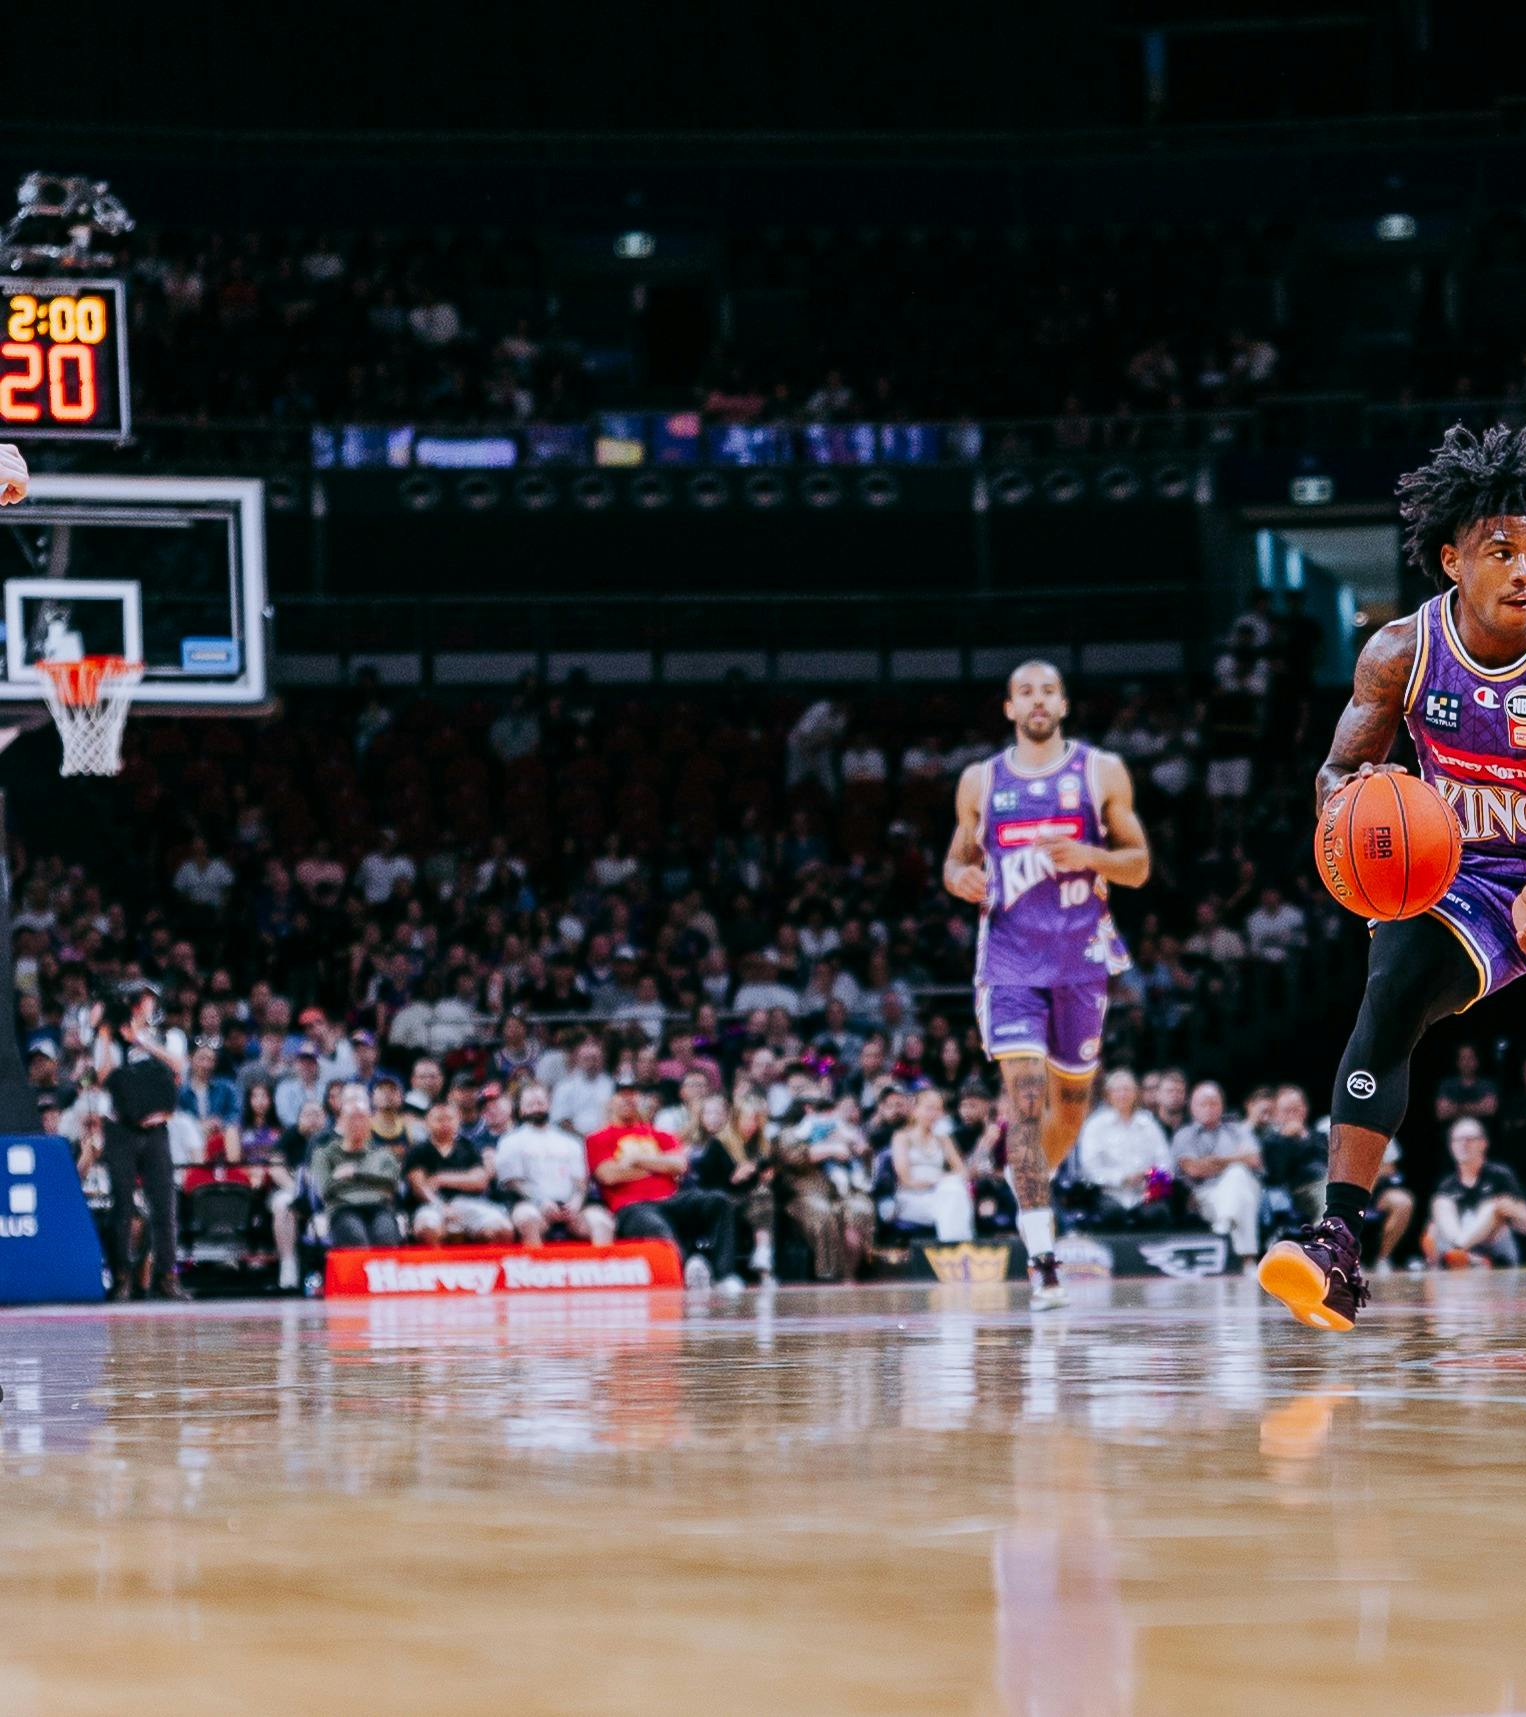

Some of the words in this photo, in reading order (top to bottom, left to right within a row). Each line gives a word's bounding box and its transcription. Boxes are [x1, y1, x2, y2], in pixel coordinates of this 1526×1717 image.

[8, 294, 106, 344] 2:00
[0, 342, 95, 421] 20
[1376, 827, 1392, 859] FIBA
[1000, 849, 1056, 911] KIN
[1059, 878, 1090, 909] 10
[363, 1259, 499, 1295] Harvey
[501, 1256, 650, 1289] Norman
